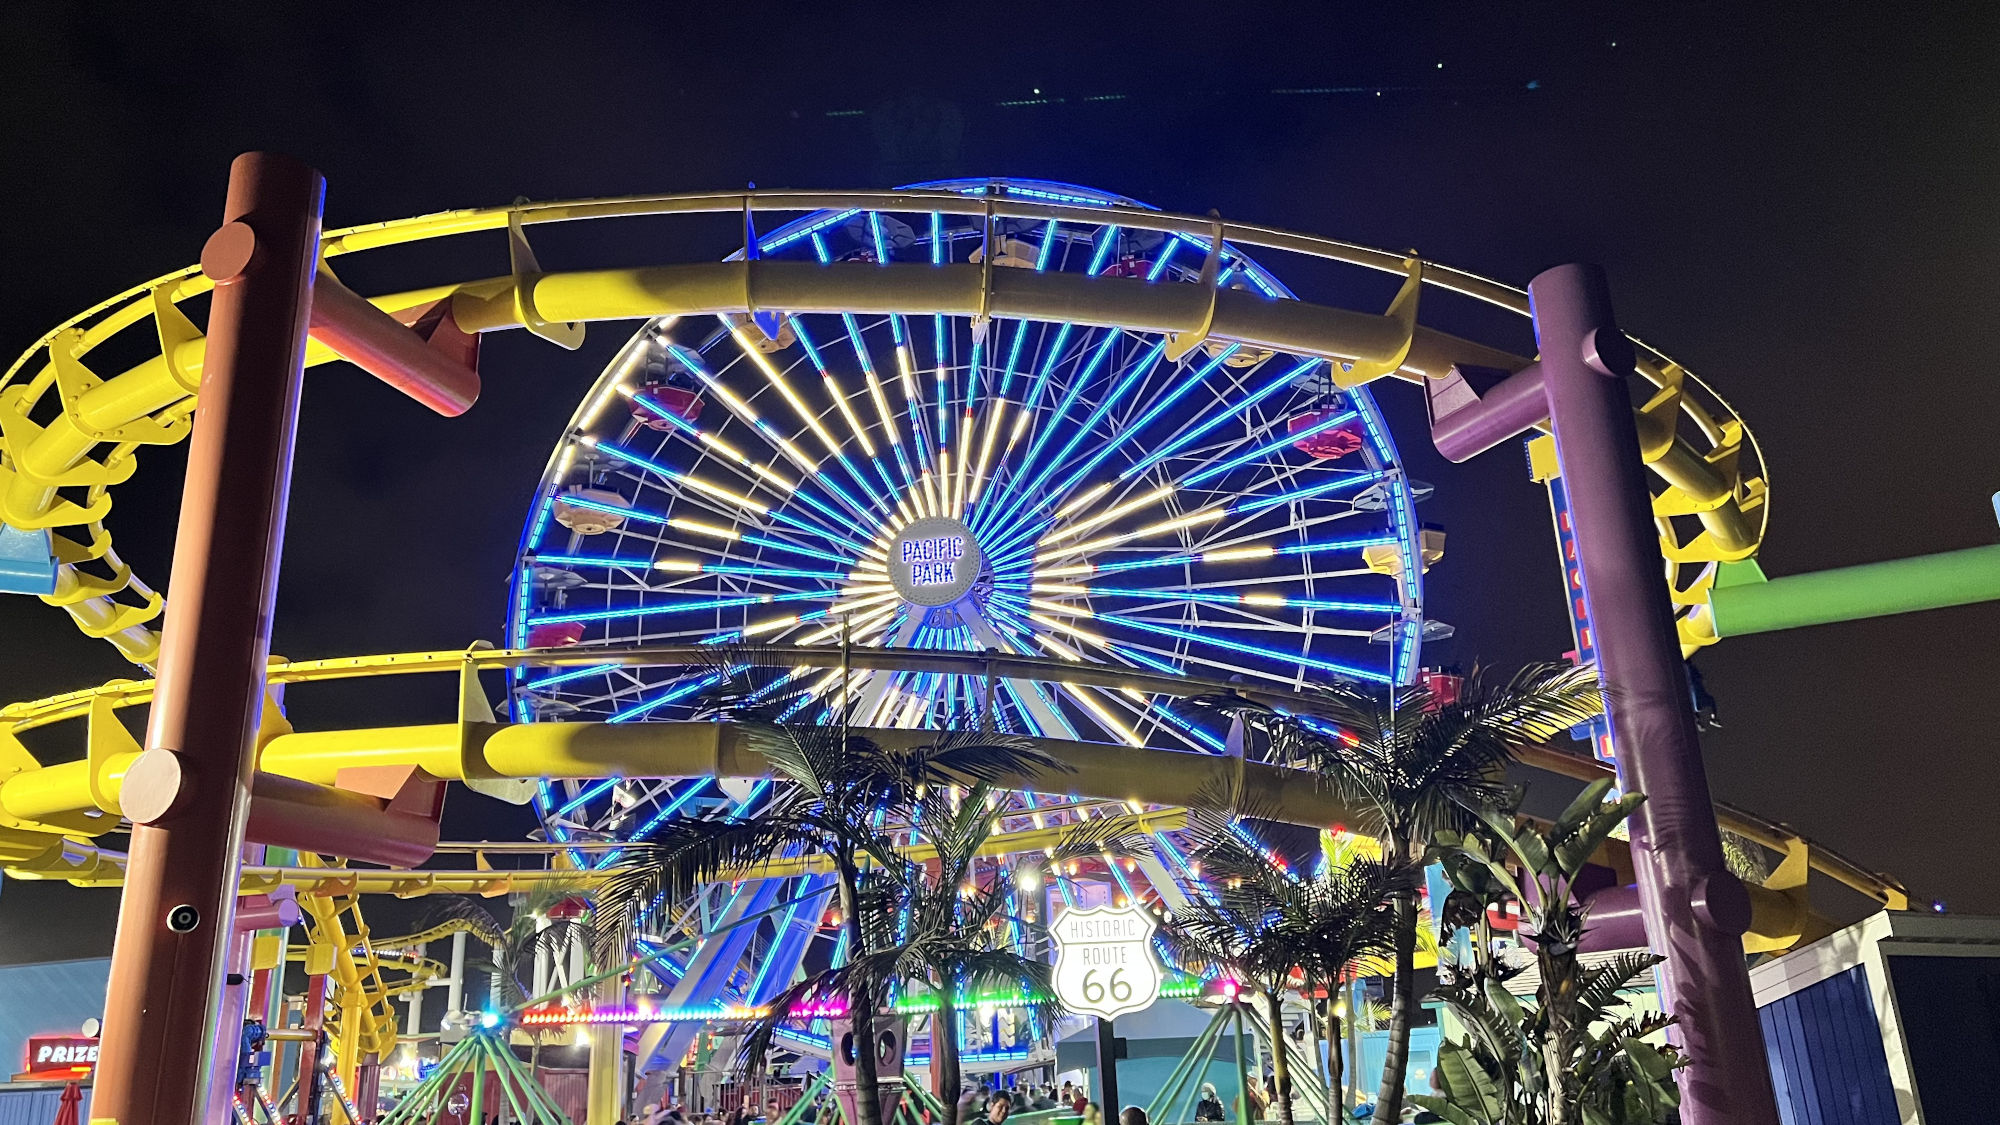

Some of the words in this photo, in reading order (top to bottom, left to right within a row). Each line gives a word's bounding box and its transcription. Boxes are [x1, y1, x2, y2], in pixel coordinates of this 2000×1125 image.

[902, 536, 963, 562] PACIFIC
[912, 561, 955, 585] PARK
[1070, 919, 1135, 938] HISTORIC
[1083, 946, 1127, 966] ROUTE
[1082, 967, 1132, 1003] 66
